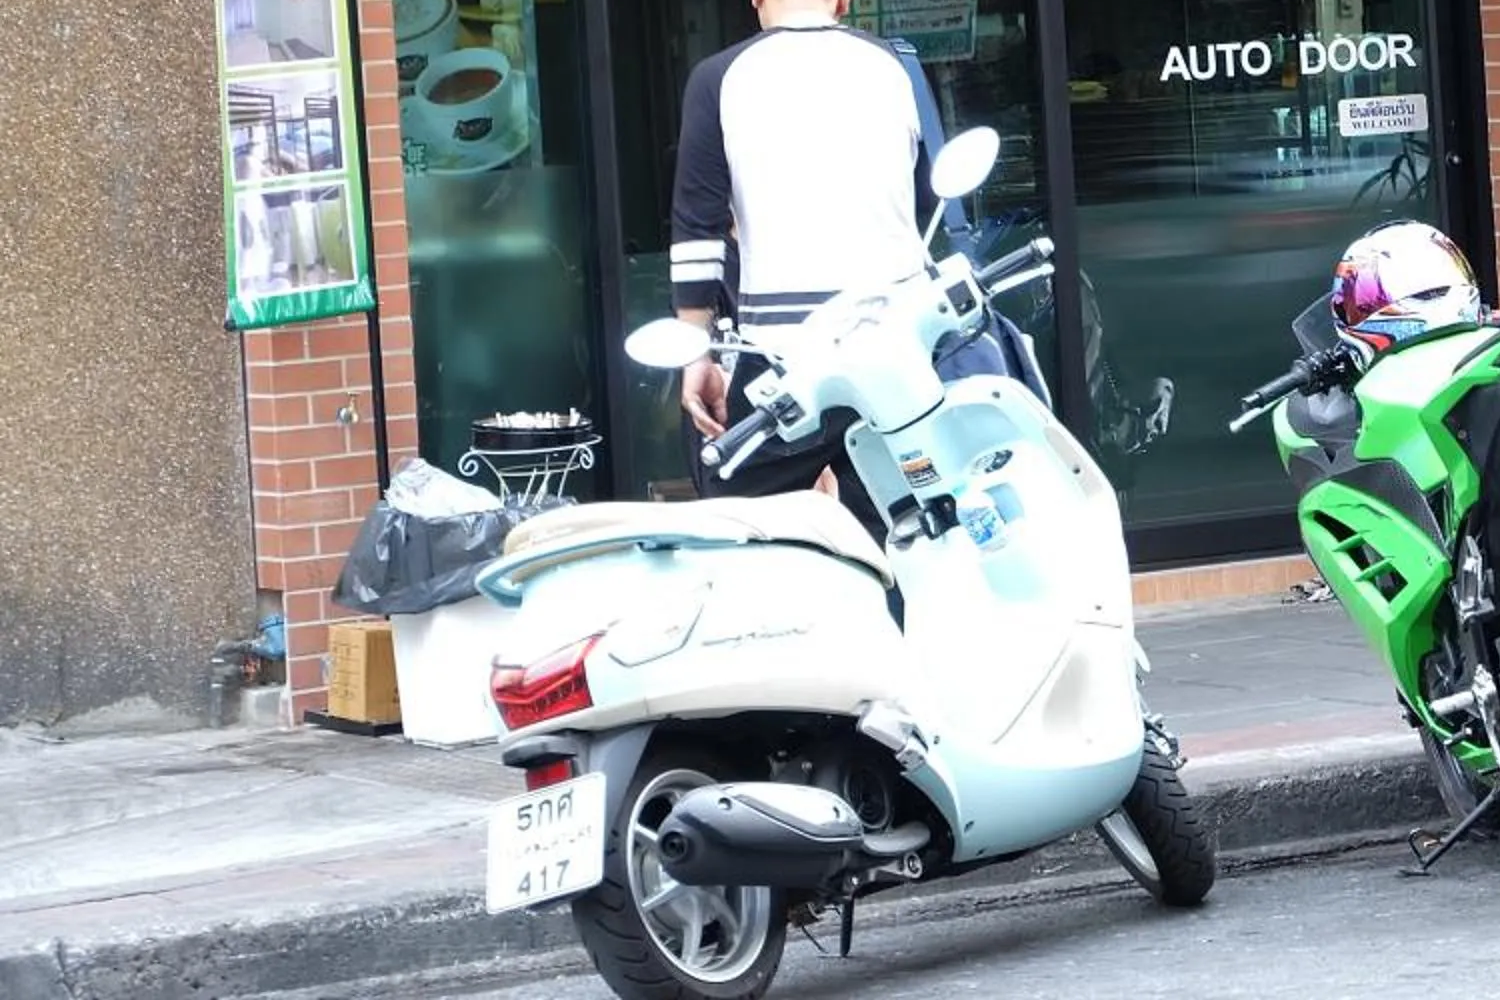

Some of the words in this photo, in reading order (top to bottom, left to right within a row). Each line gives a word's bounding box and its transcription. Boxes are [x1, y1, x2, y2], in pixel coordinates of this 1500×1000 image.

[1160, 41, 1272, 82] AUTO
[1300, 33, 1417, 75] DOOR
[517, 859, 570, 896] 417
